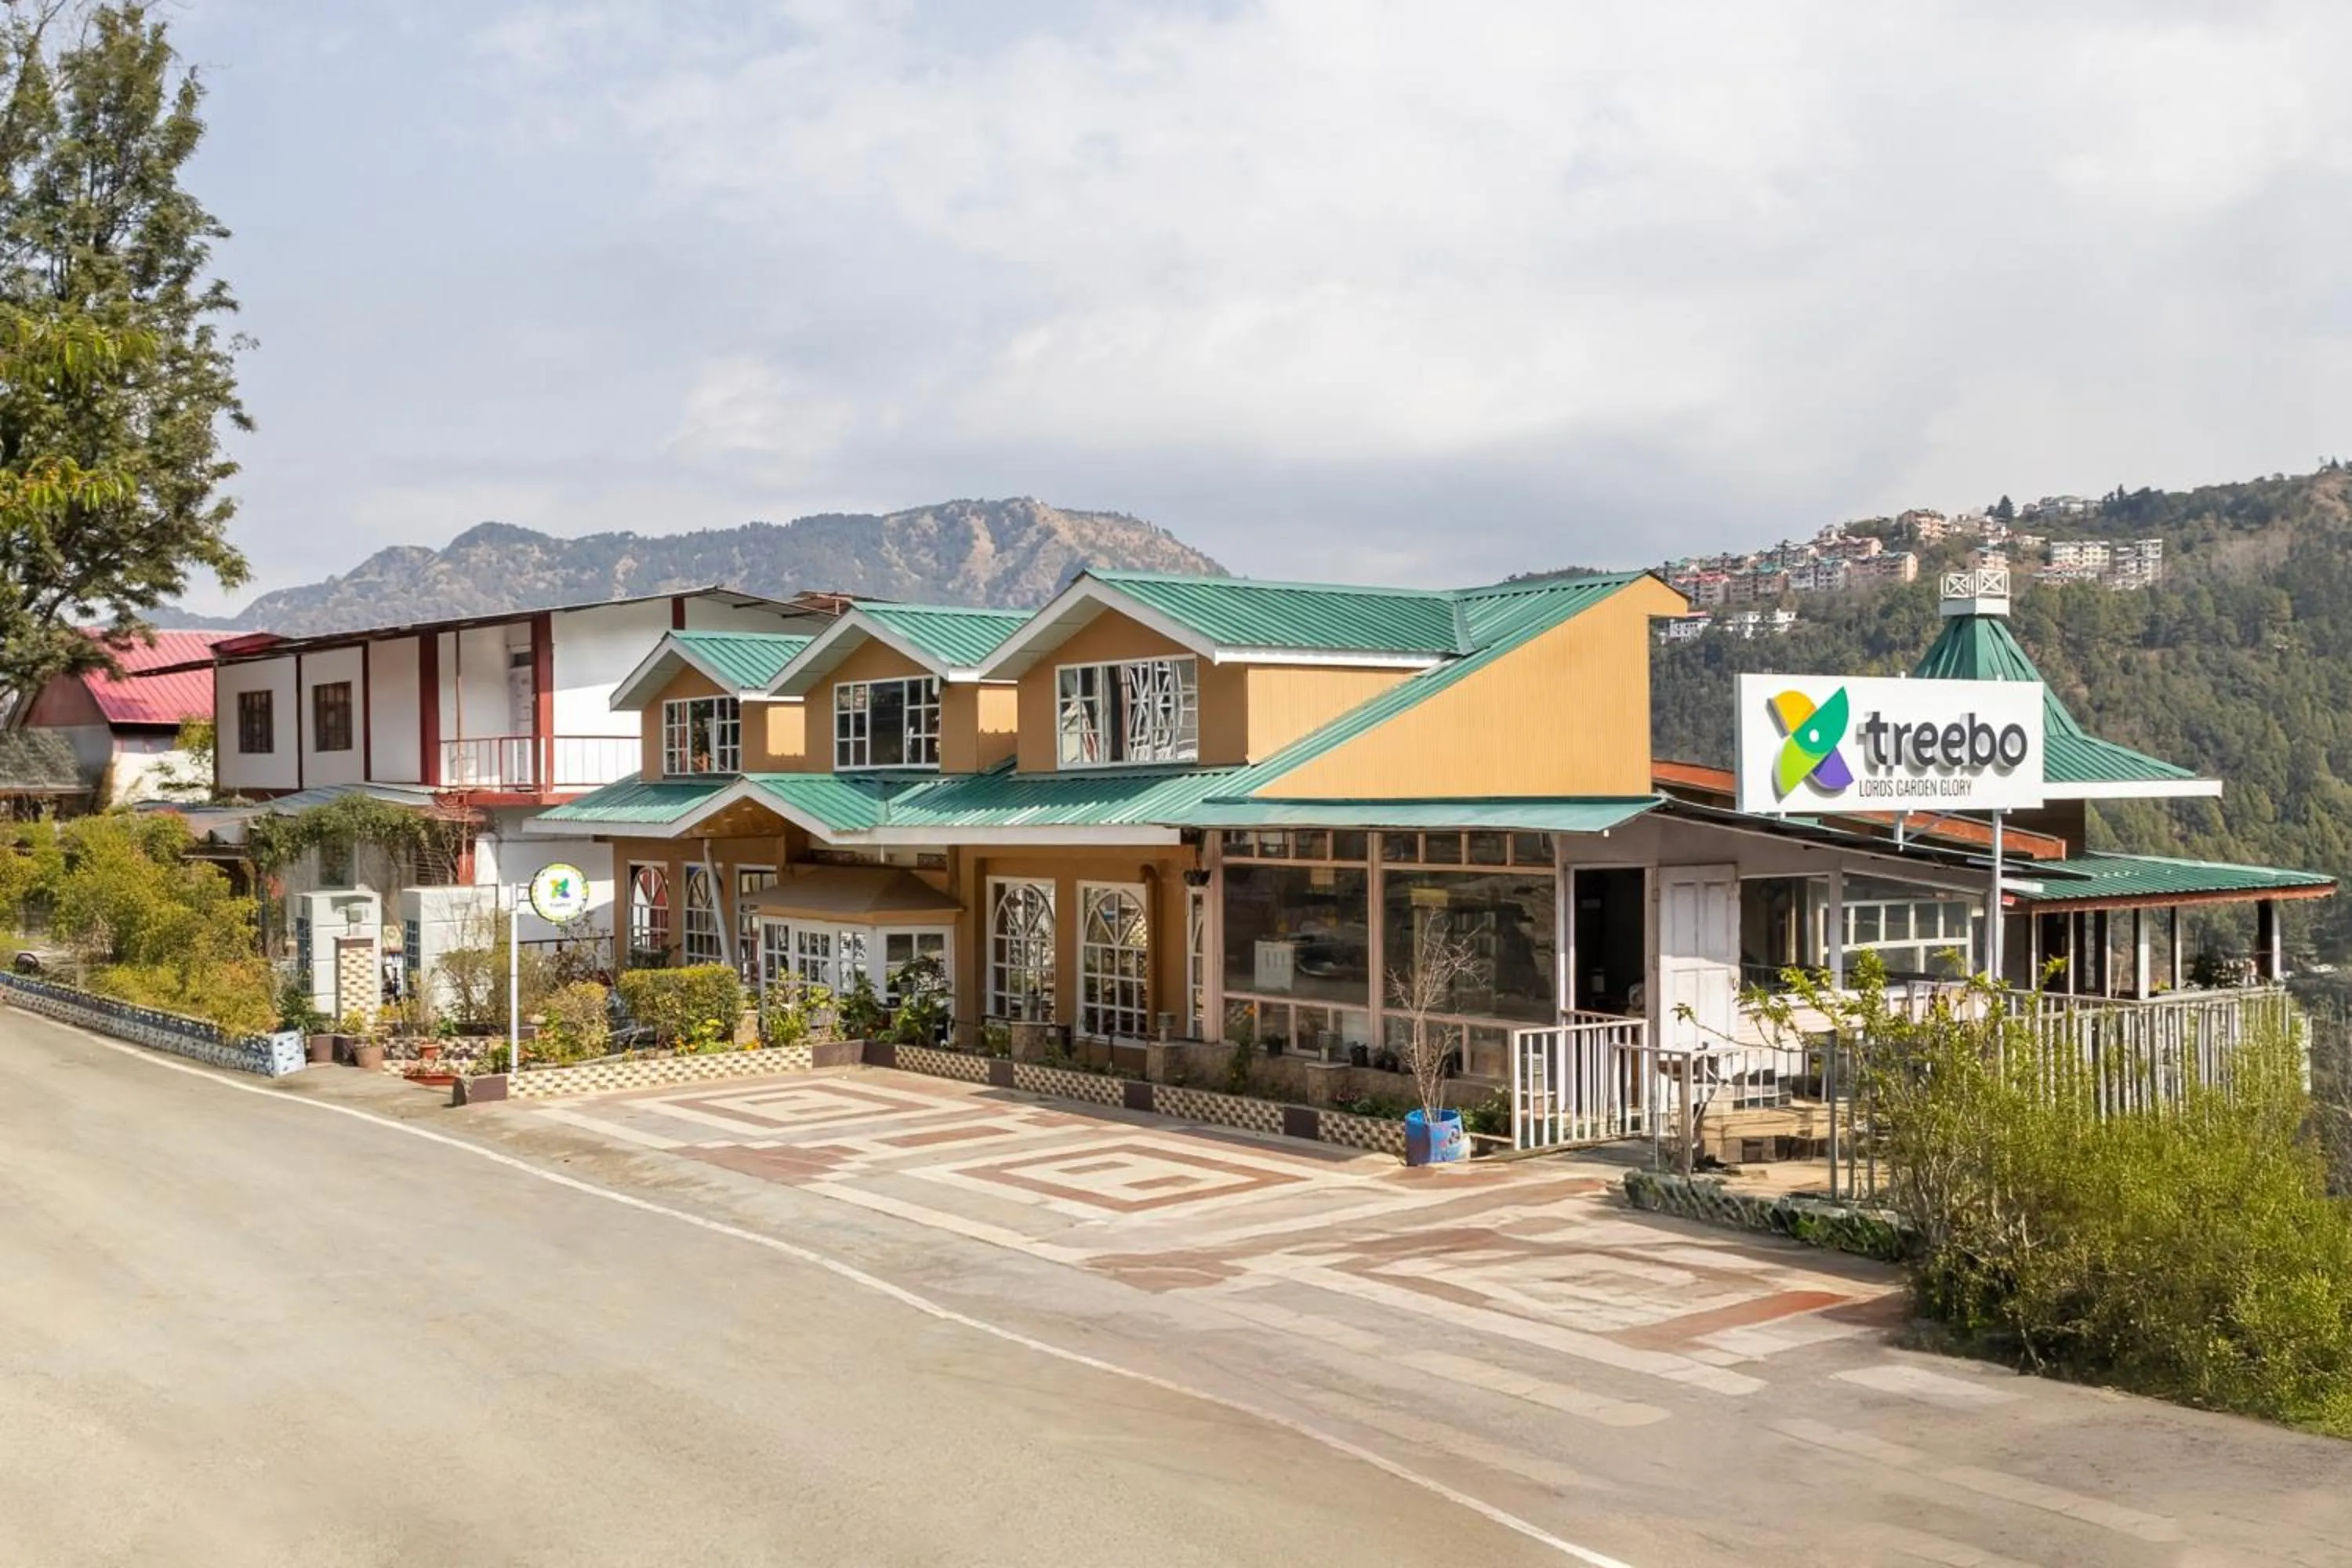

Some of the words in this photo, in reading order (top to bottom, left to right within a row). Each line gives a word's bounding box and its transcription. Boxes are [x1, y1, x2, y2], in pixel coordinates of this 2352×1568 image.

[1865, 711, 2027, 766] treebo
[1859, 779, 1893, 797] LORDS
[1896, 779, 1937, 797] GARDEN
[1940, 779, 1972, 797] GLORY
